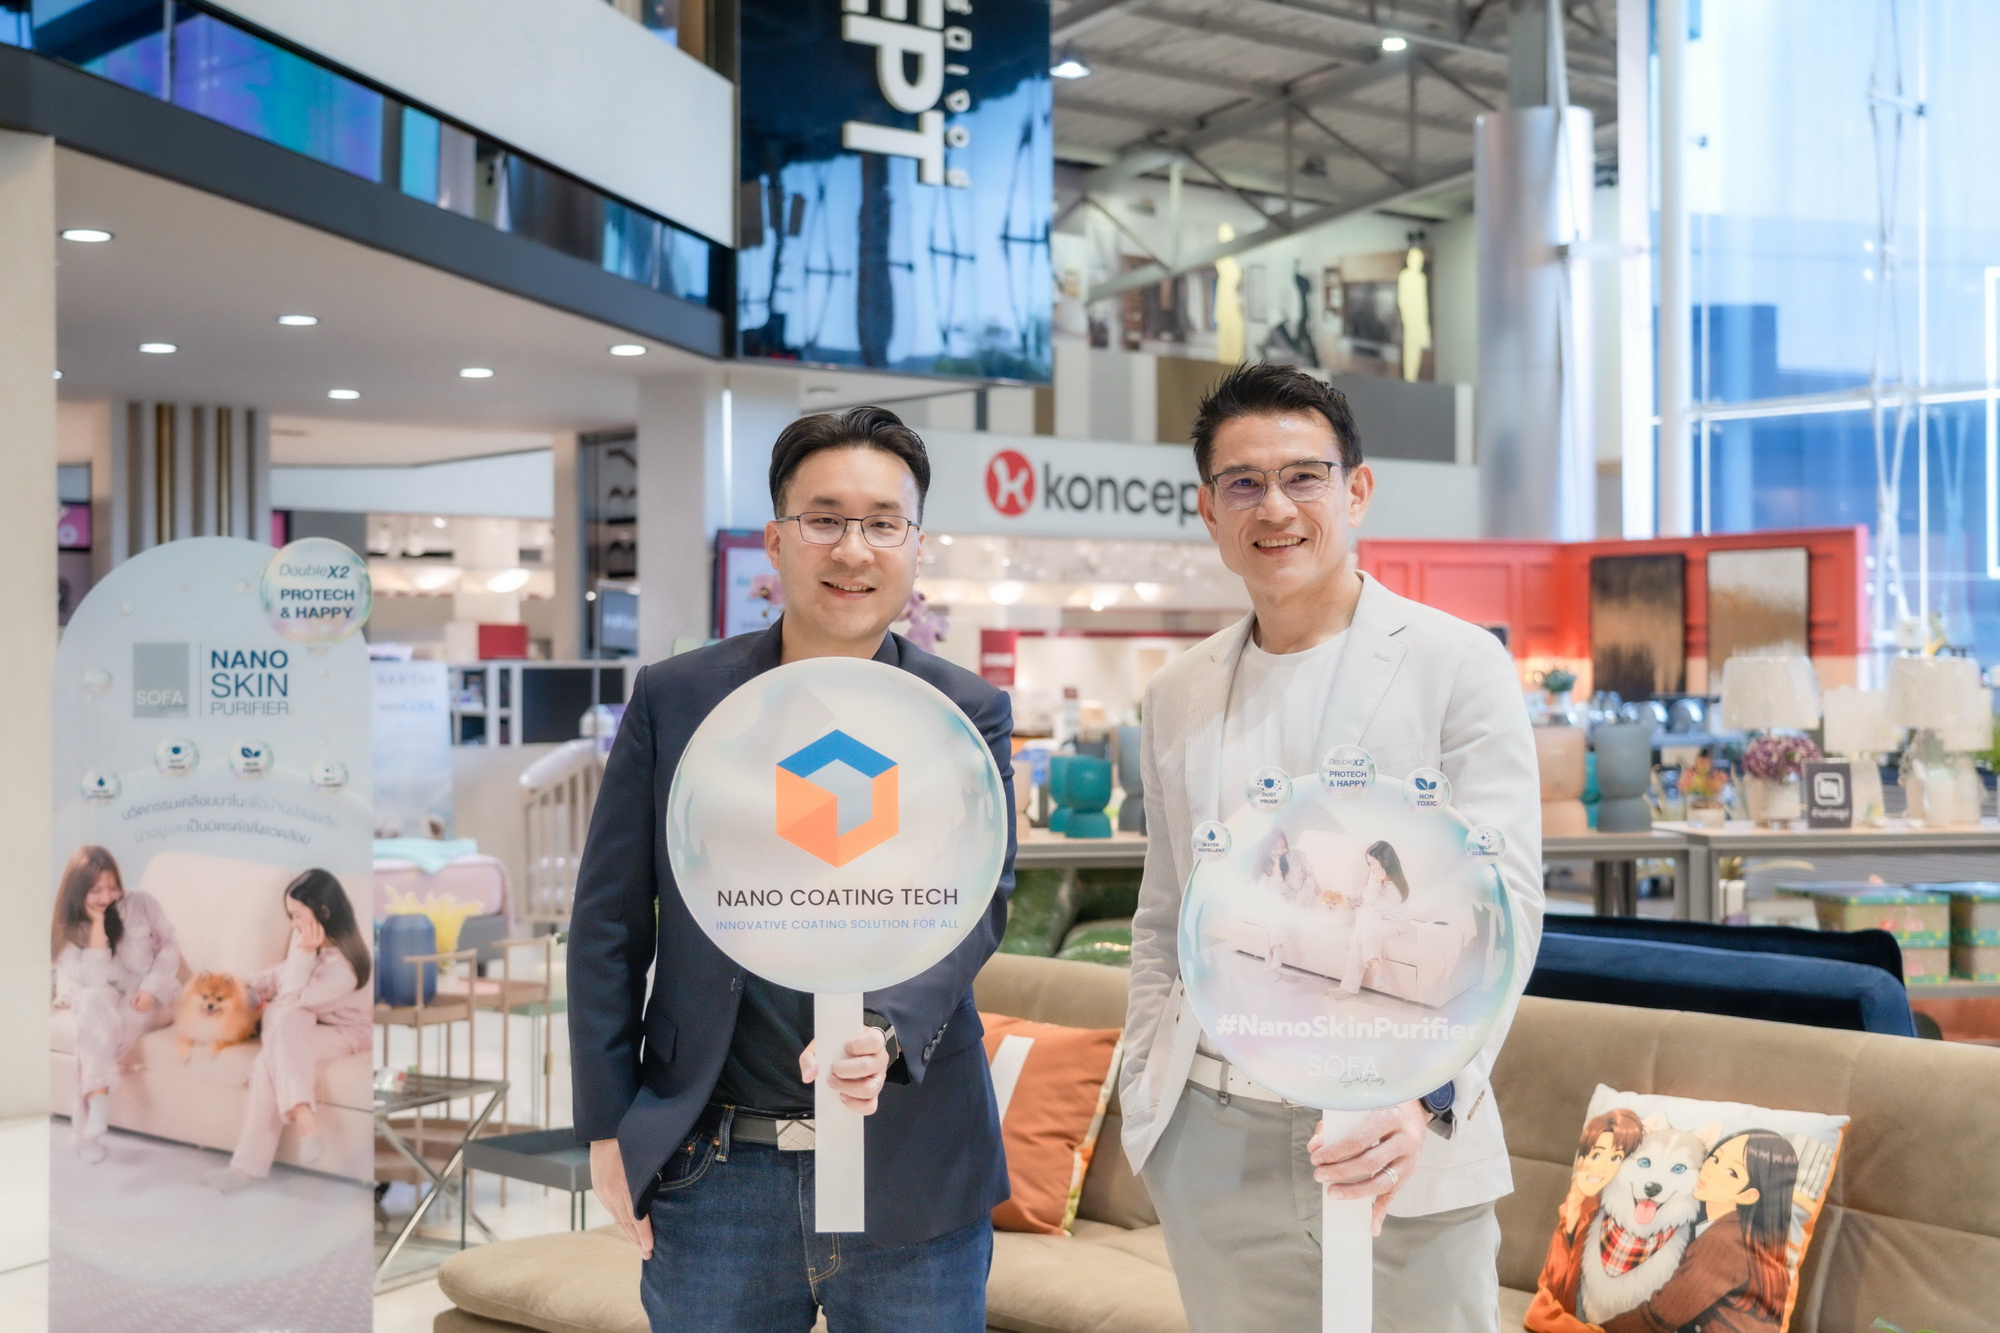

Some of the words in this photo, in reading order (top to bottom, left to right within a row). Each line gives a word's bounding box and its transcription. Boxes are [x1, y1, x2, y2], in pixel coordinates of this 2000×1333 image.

[280, 588, 355, 601] PROTECH
[280, 606, 291, 619] &
[296, 606, 354, 619] HAPPY
[211, 649, 289, 669] NANO
[211, 672, 288, 698] SKIN
[136, 690, 184, 706] SOFA
[211, 700, 289, 716] PURIFIER
[1336, 780, 1367, 788] HAPPY
[717, 889, 784, 907] NANO
[790, 888, 894, 906] COATING
[900, 888, 959, 906] TECH
[716, 920, 788, 930] INNOVATIVE
[791, 919, 847, 929] COATING
[850, 919, 909, 929] SOLUTION
[913, 919, 936, 929] FOR
[940, 918, 959, 929] ALL
[1215, 1013, 1481, 1041] #NanoSkinPurifier
[1307, 1055, 1379, 1078] SOFA
